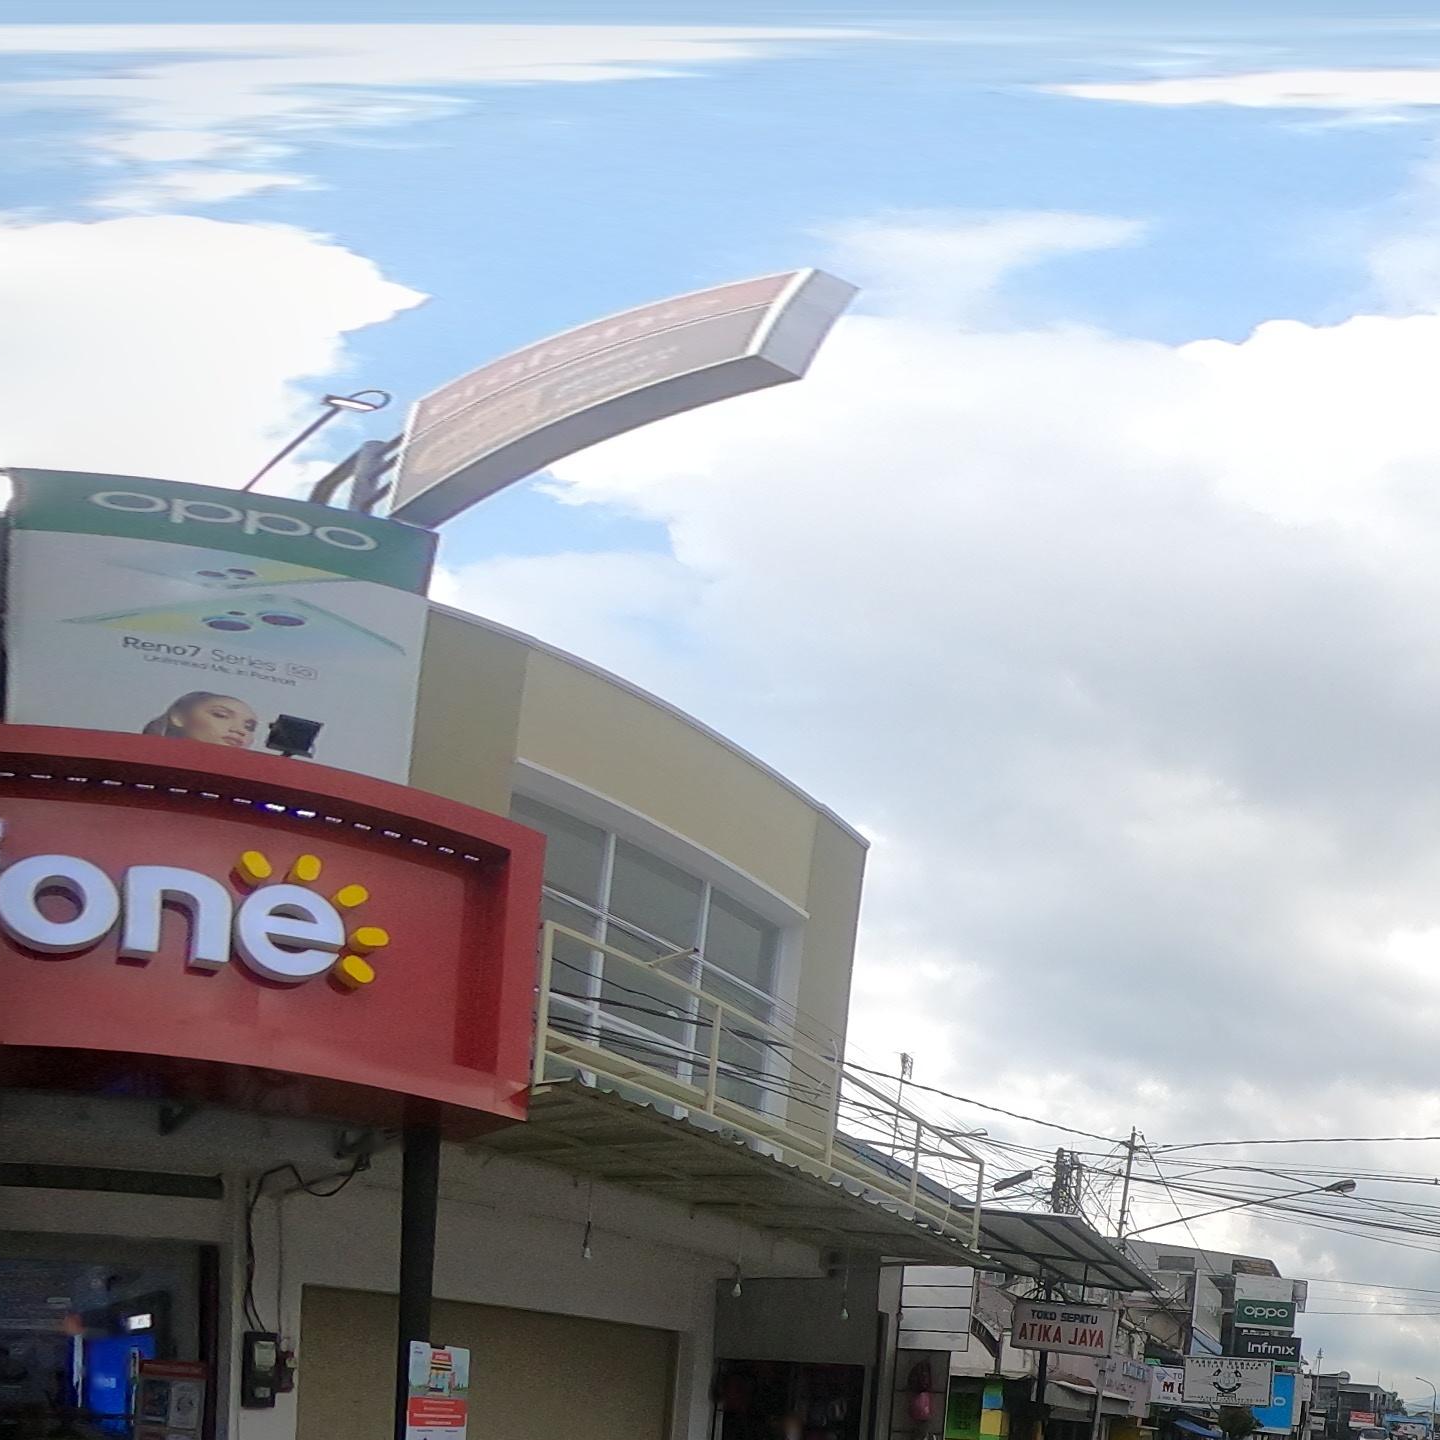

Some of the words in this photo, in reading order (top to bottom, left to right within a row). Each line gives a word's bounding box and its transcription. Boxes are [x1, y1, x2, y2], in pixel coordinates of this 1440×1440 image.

[90, 490, 378, 551] oppo
[122, 635, 201, 657] Reno7
[210, 648, 277, 672] Series
[1244, 1306, 1288, 1320] oppo
[1019, 1323, 1062, 1343] ATIKA
[1068, 1327, 1104, 1349] JAYA
[1248, 1341, 1295, 1356] Infinix
